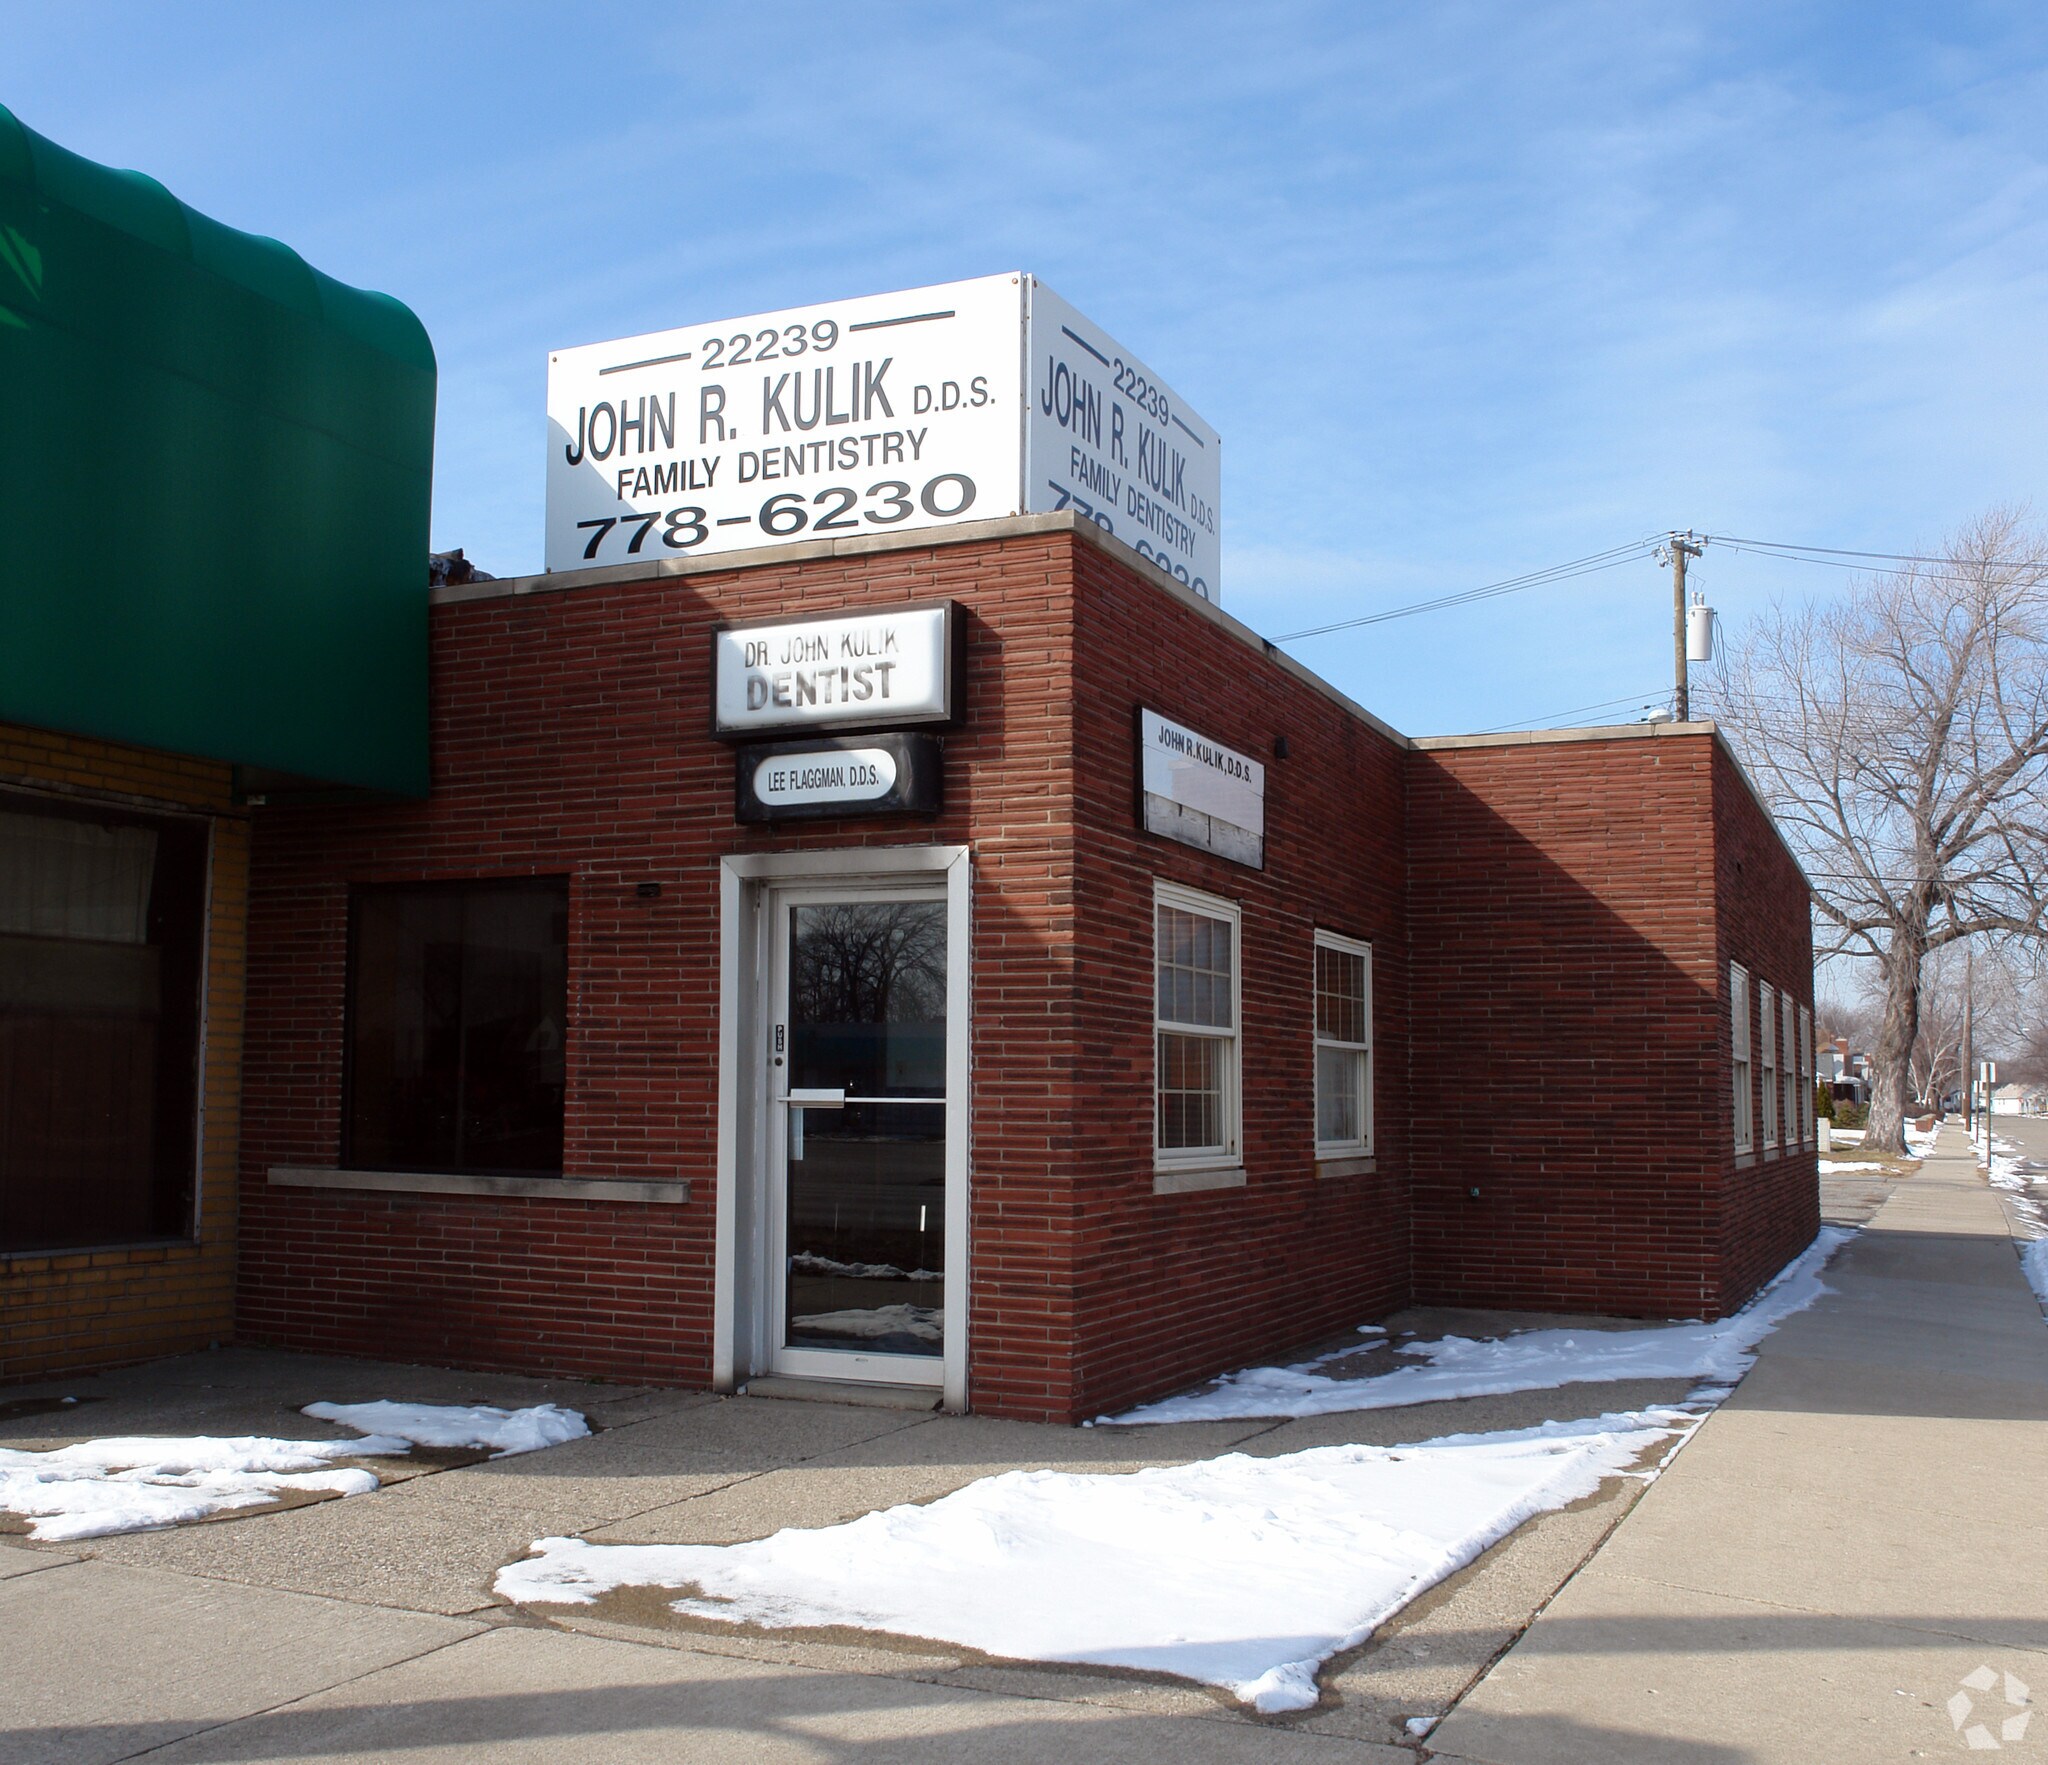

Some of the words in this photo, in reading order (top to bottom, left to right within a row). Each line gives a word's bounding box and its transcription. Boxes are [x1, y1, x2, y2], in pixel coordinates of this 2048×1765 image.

[701, 320, 839, 370] 22239
[565, 391, 676, 467] JOHN
[700, 384, 737, 444] R.
[762, 357, 895, 435] KULIK
[913, 376, 997, 415] D.D.S.
[1113, 358, 1169, 426] 22239
[617, 456, 721, 500] FAMILY
[738, 427, 928, 484] DENTISTRY
[1041, 355, 1102, 450] JOHN
[1111, 401, 1129, 470] R.
[1138, 421, 1187, 512] KULIK
[1190, 493, 1216, 536] D.D.S.
[576, 473, 978, 559] 778-6230
[1070, 445, 1122, 507] FAMILY
[1127, 485, 1197, 559] DENTISTRY
[744, 641, 772, 668] DR.
[780, 635, 830, 664] JOHN
[746, 661, 896, 711] DENTIST
[1158, 725, 1185, 754] JOHN
[768, 772, 785, 792] LEE
[789, 766, 846, 791] FLAGGMAN,
[849, 765, 879, 786] D.D.S.
